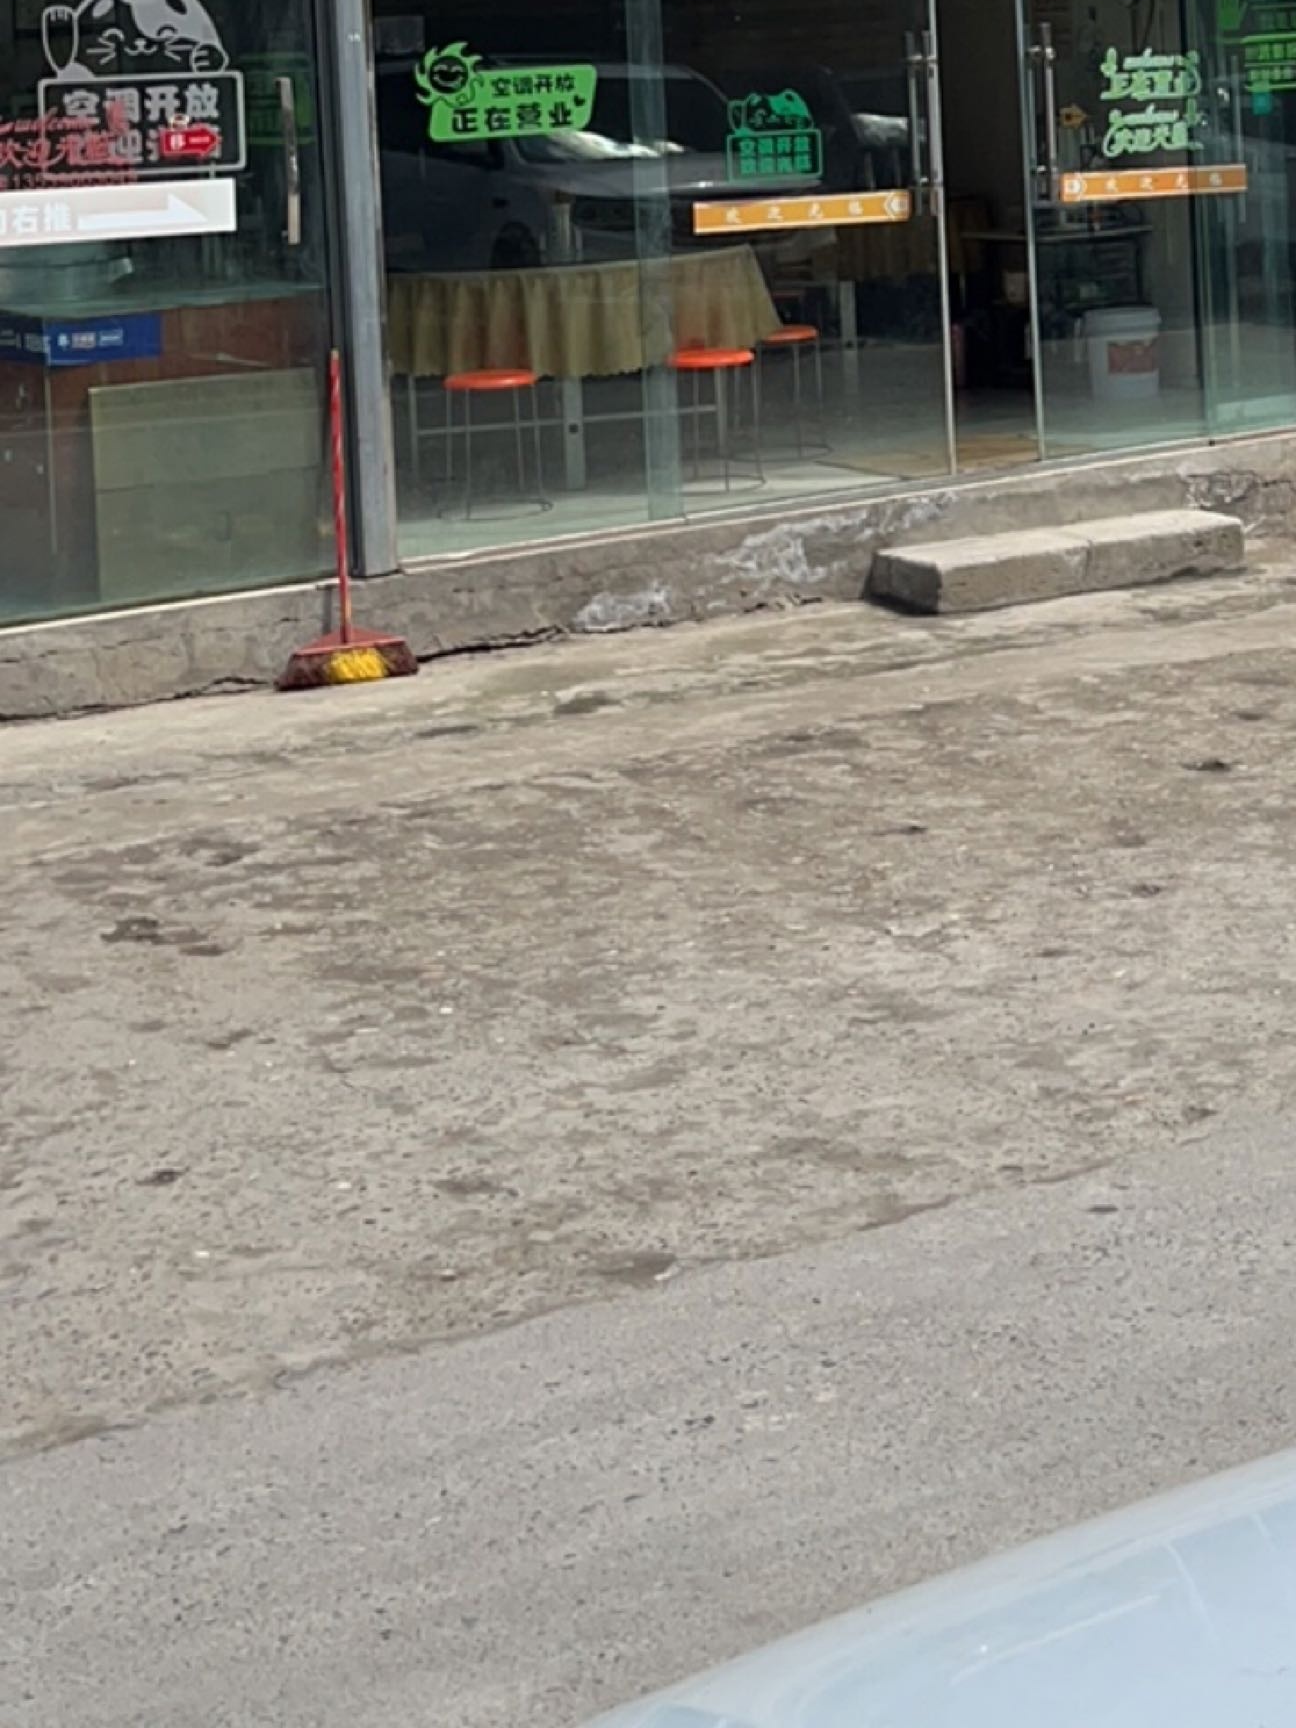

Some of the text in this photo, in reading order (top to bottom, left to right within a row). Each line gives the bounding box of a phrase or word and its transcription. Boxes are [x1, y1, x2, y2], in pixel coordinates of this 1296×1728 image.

[490, 73, 576, 98] 空调开放
[62, 83, 219, 124] 空调开放
[451, 102, 572, 133] 正在营业
[0, 200, 71, 235] 右推
